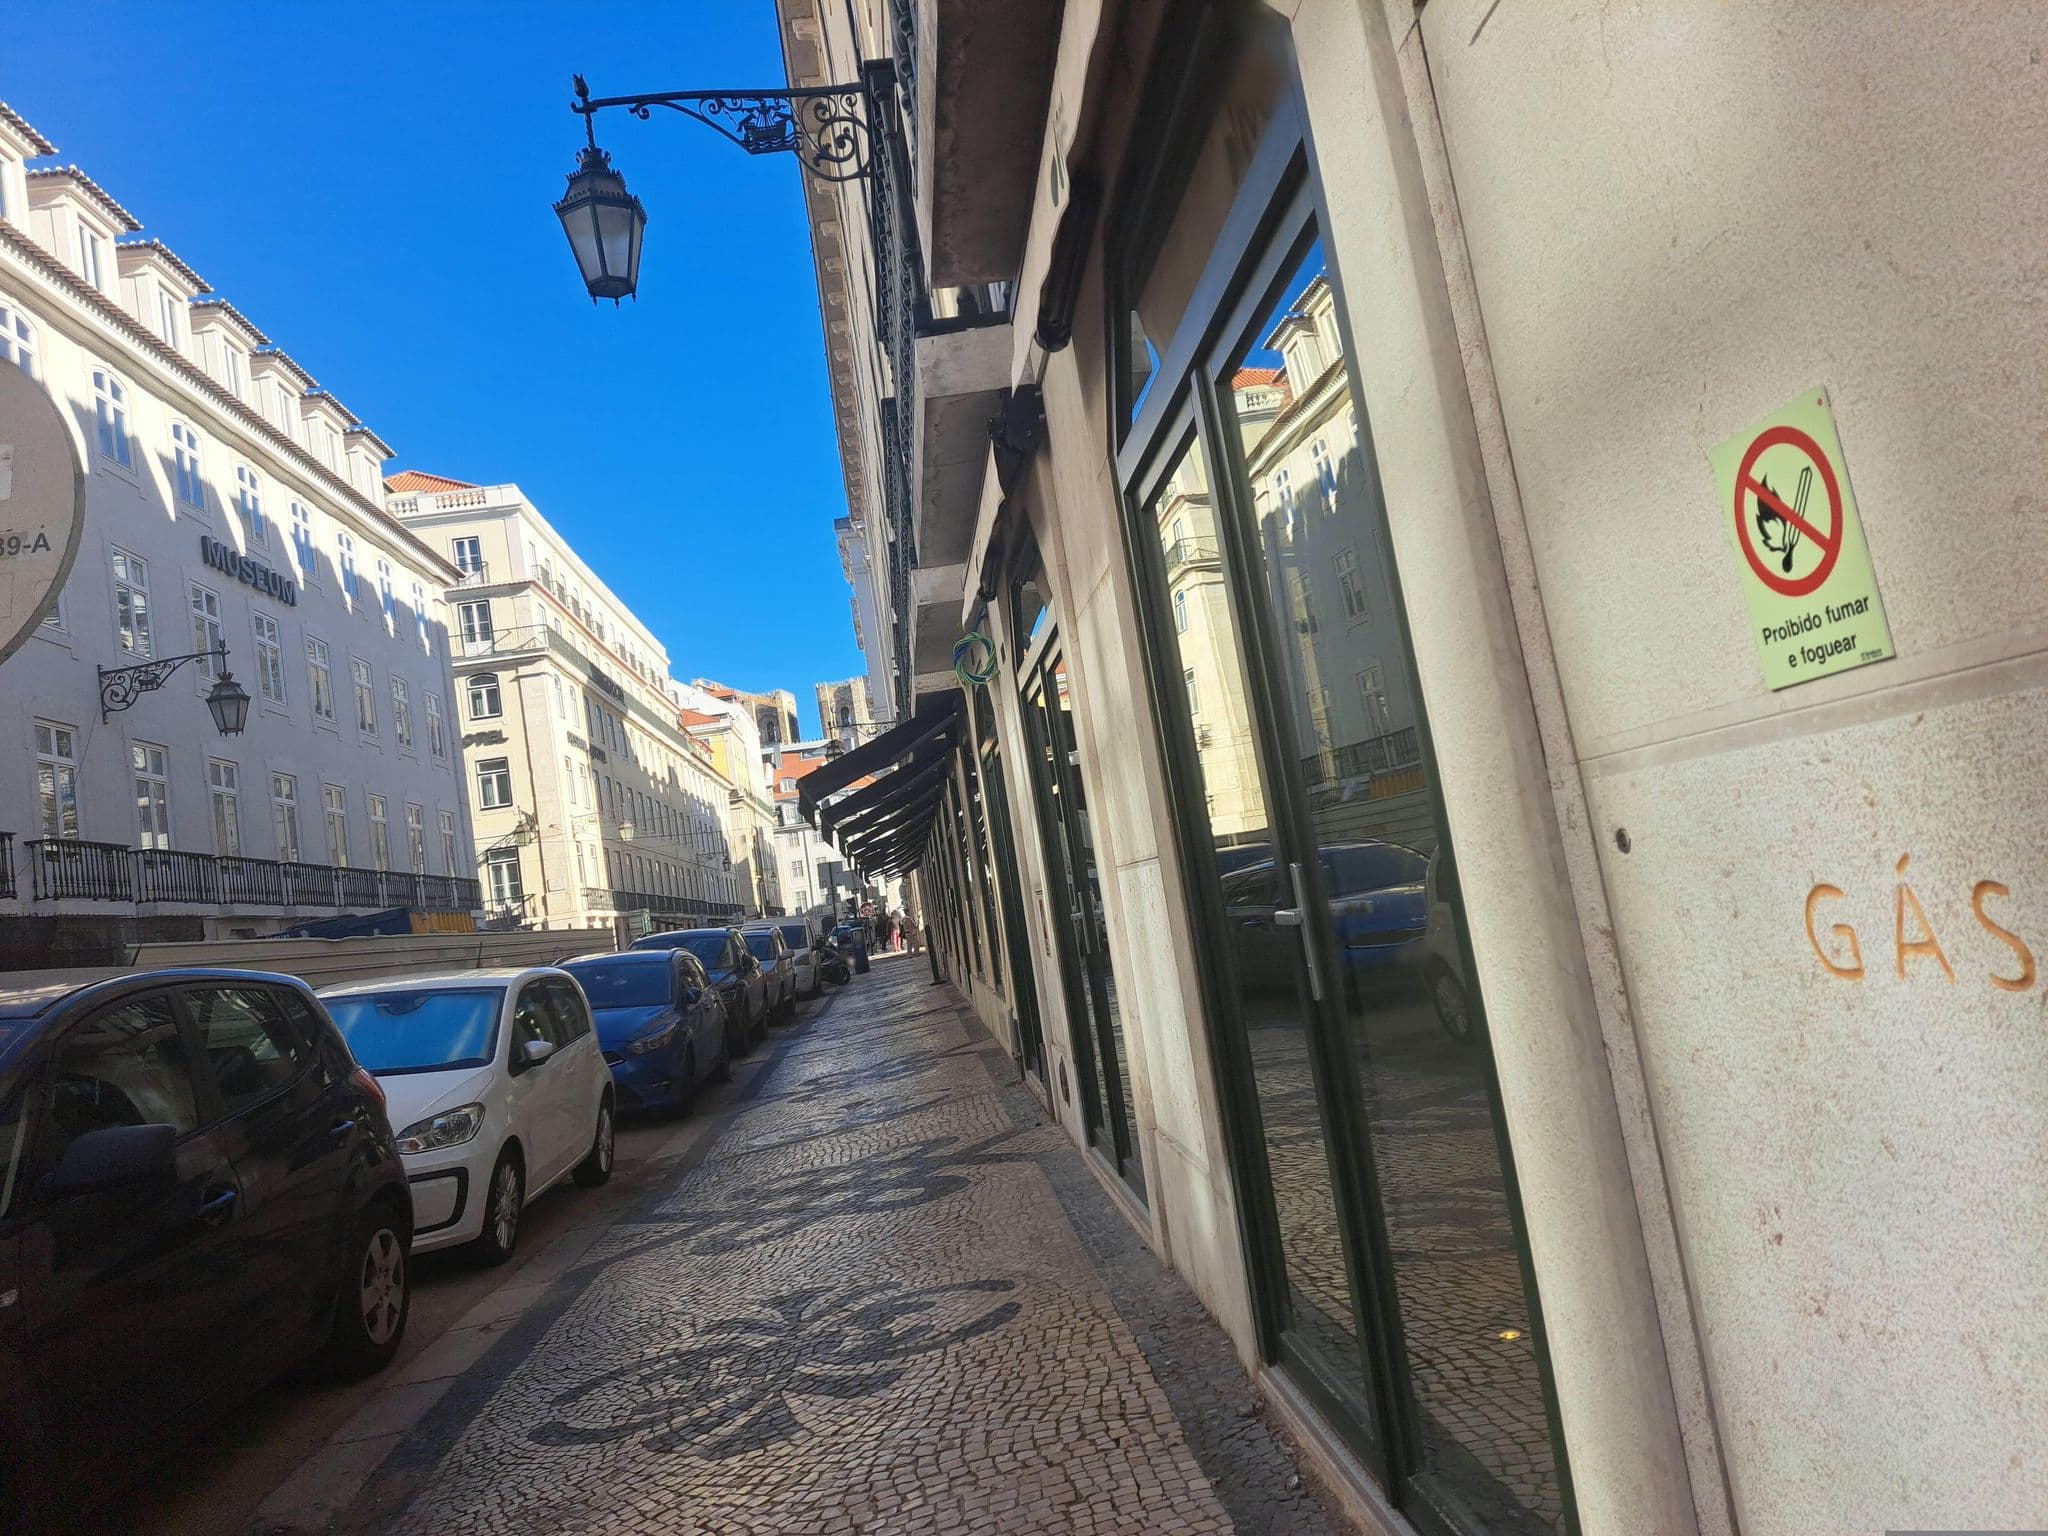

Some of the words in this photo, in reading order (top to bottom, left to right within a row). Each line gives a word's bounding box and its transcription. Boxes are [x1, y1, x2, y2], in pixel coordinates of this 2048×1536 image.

[200, 535, 296, 607] MUSEUM
[1762, 613, 1822, 645] Proibido
[1825, 596, 1870, 624] fumar
[1788, 653, 1797, 668] e
[1801, 634, 1857, 665] foguear
[1804, 851, 2037, 992] GÁS
